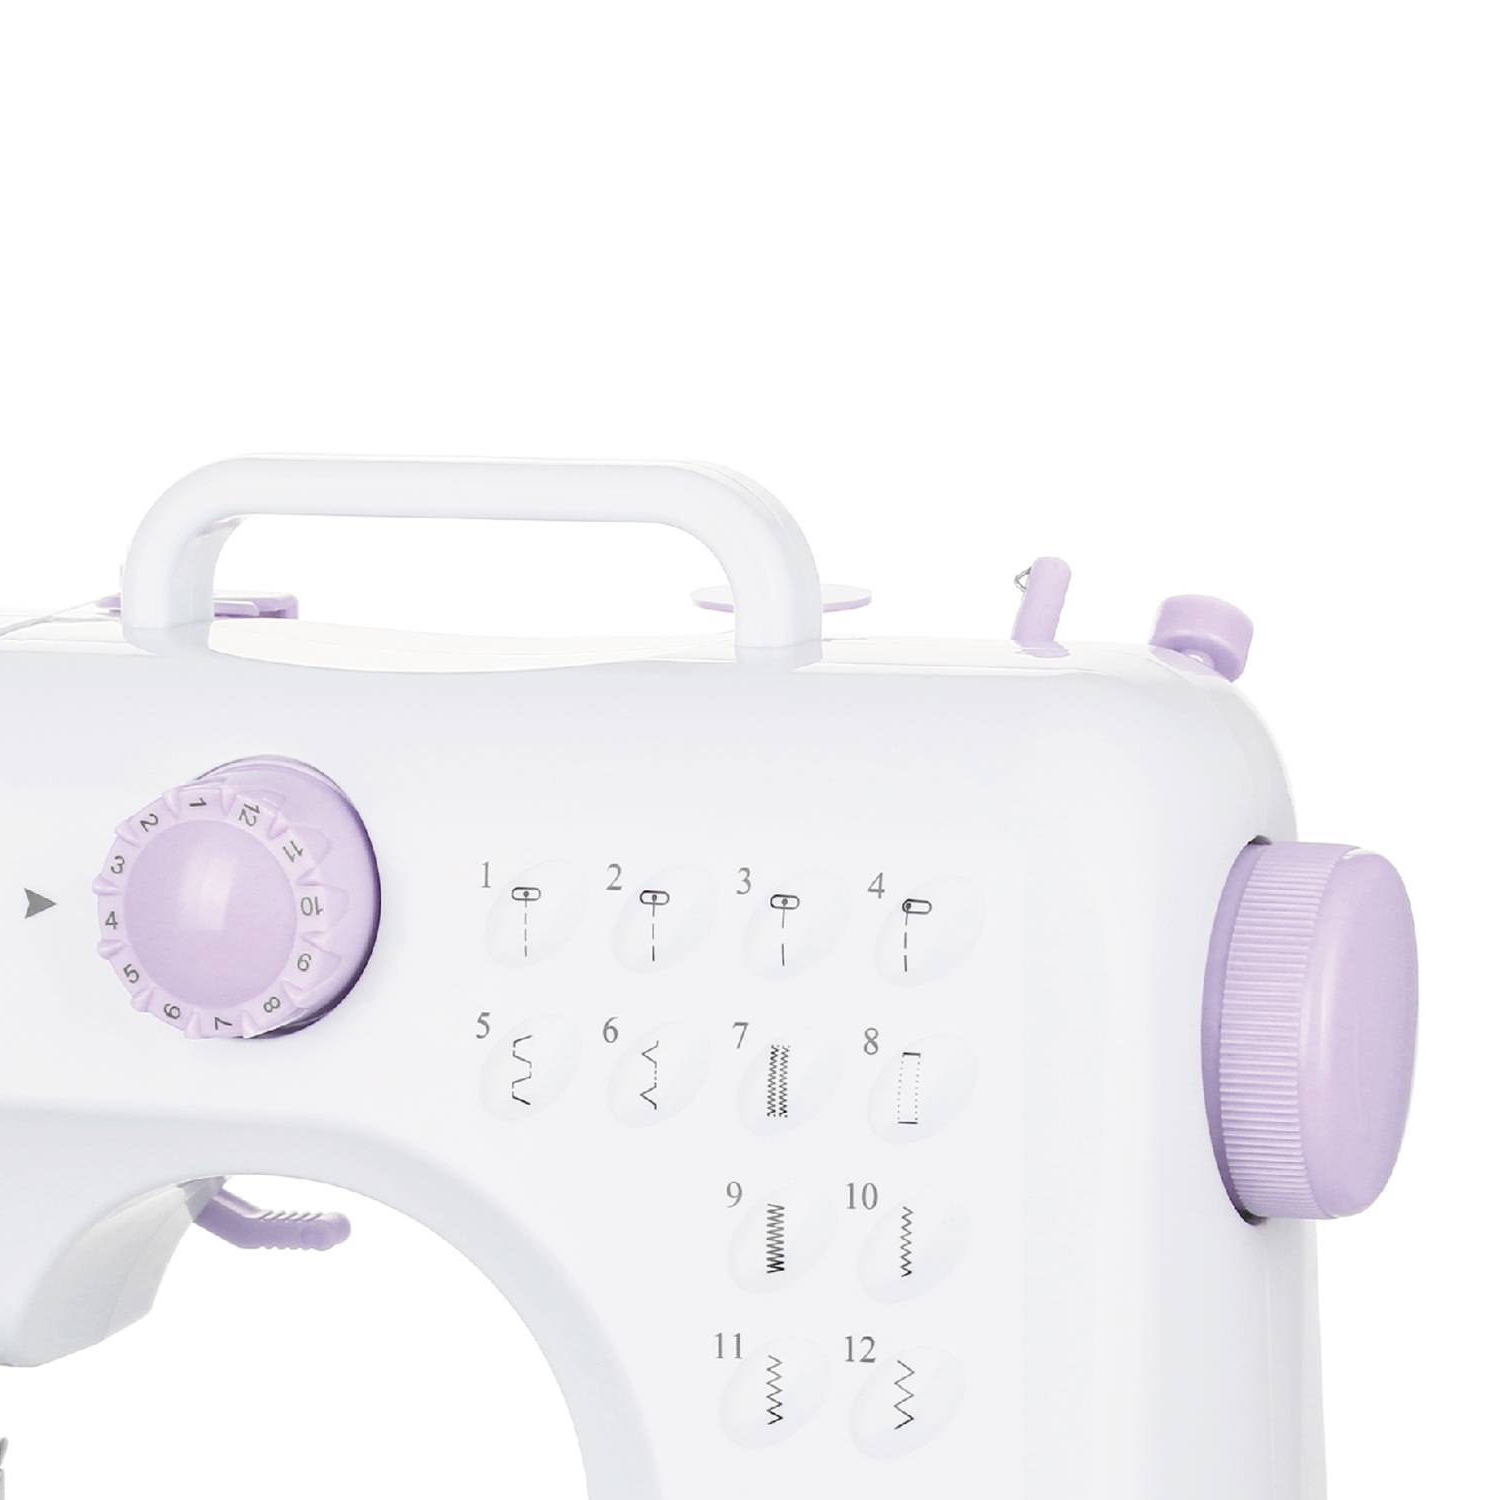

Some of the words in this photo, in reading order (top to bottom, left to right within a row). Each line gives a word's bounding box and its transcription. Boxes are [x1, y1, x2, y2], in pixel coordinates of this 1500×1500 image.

[188, 797, 208, 809] 1
[238, 802, 261, 828] 12
[139, 812, 159, 833] 2
[110, 854, 126, 875] 3
[281, 840, 304, 864] 11
[480, 862, 492, 888] 1
[606, 864, 623, 891] 2
[736, 867, 752, 894] 3
[868, 873, 885, 899] 4
[299, 895, 324, 916] 10
[104, 910, 119, 930] 4
[122, 963, 140, 984] 5
[296, 952, 313, 973] 9
[162, 1002, 182, 1021] 6
[262, 995, 282, 1014] 8
[213, 1016, 233, 1031] 7
[476, 1012, 491, 1038] 5
[602, 1016, 619, 1043] 6
[732, 1022, 748, 1049] 7
[863, 1028, 879, 1055] 8
[726, 1182, 743, 1208] 9
[846, 1182, 878, 1210] 10
[714, 1333, 743, 1359] 11
[844, 1336, 877, 1364] 12
